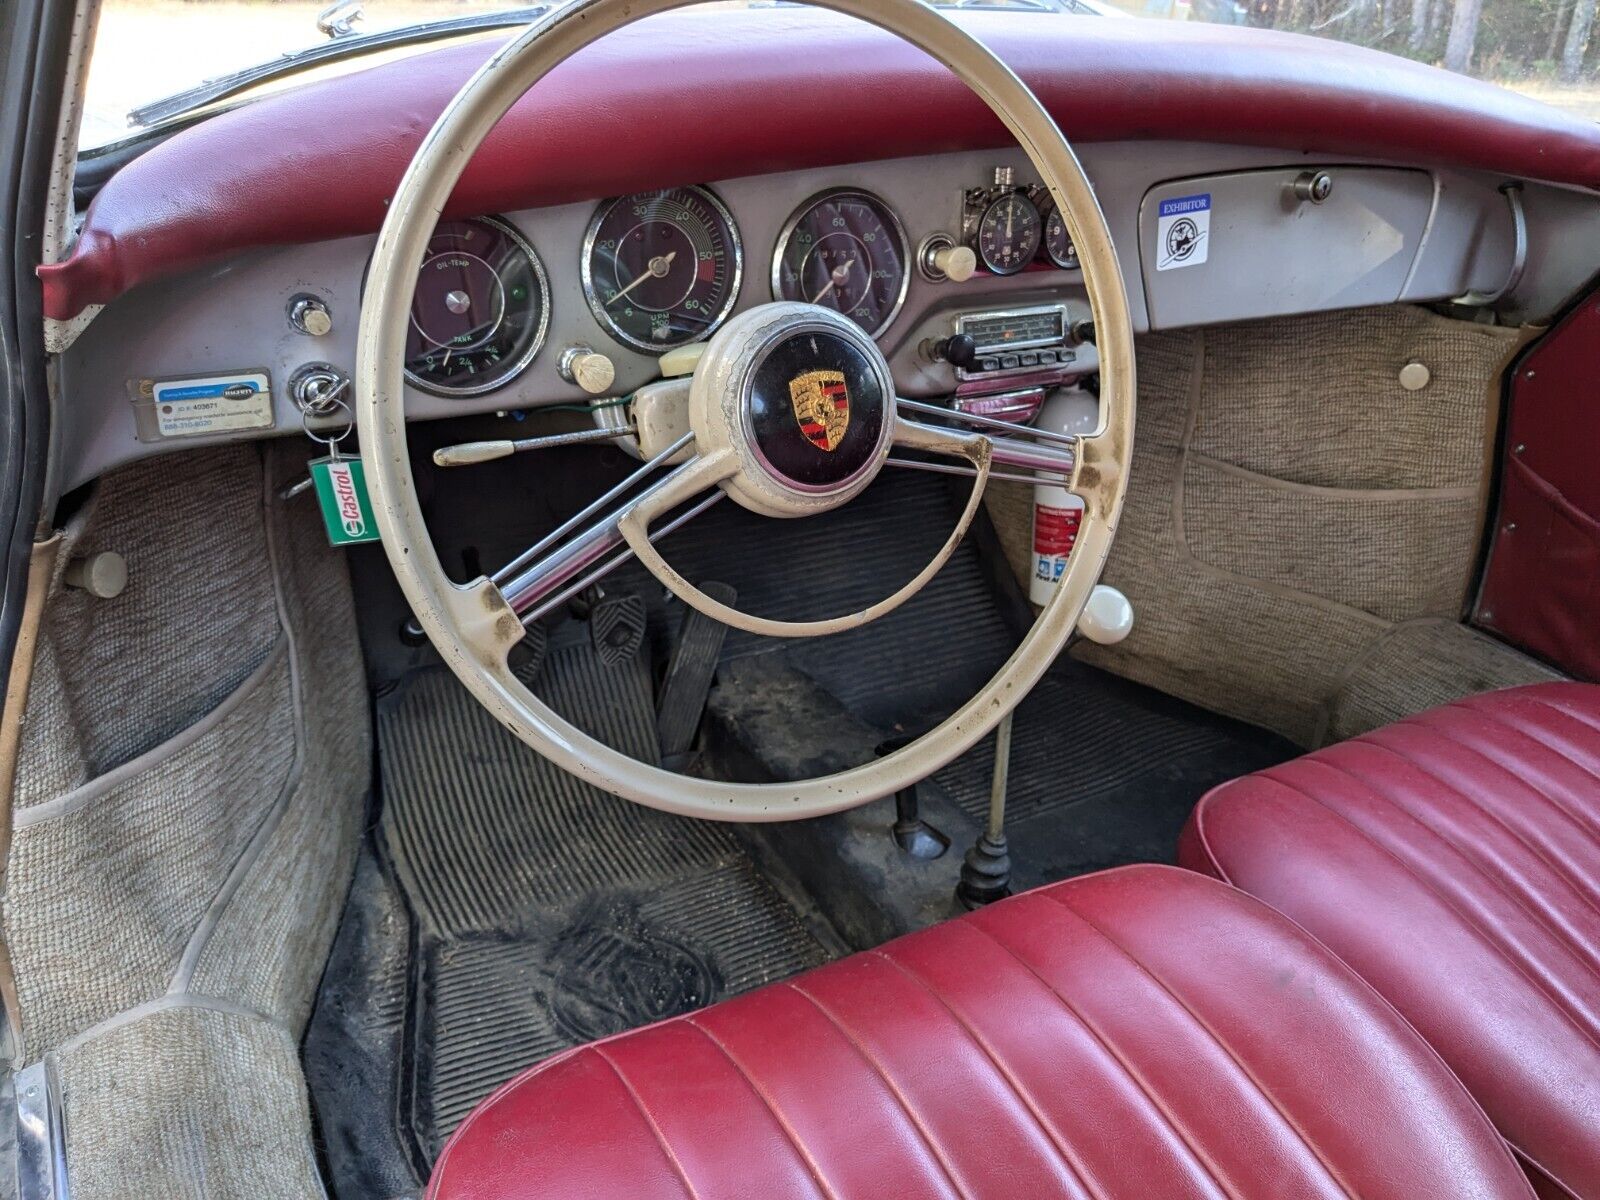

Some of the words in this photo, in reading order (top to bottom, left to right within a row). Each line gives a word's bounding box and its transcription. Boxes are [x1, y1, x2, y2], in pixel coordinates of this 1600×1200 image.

[633, 206, 648, 216] 30
[1163, 199, 1207, 214] EXHIBITOR
[675, 211, 689, 221] 40
[832, 218, 845, 227] 60
[1053, 226, 1060, 235] 9
[798, 234, 812, 243] 40
[863, 233, 876, 242] 80
[599, 239, 615, 249] 20
[1068, 245, 1074, 255] 6
[699, 251, 713, 260] 50
[436, 260, 470, 270] OIL-TEMP
[685, 300, 699, 310] 60
[651, 313, 670, 321] UPM
[855, 308, 870, 317] 120
[484, 346, 498, 354] 4/4
[459, 357, 472, 366] 2/4
[333, 470, 359, 519] Castrol
